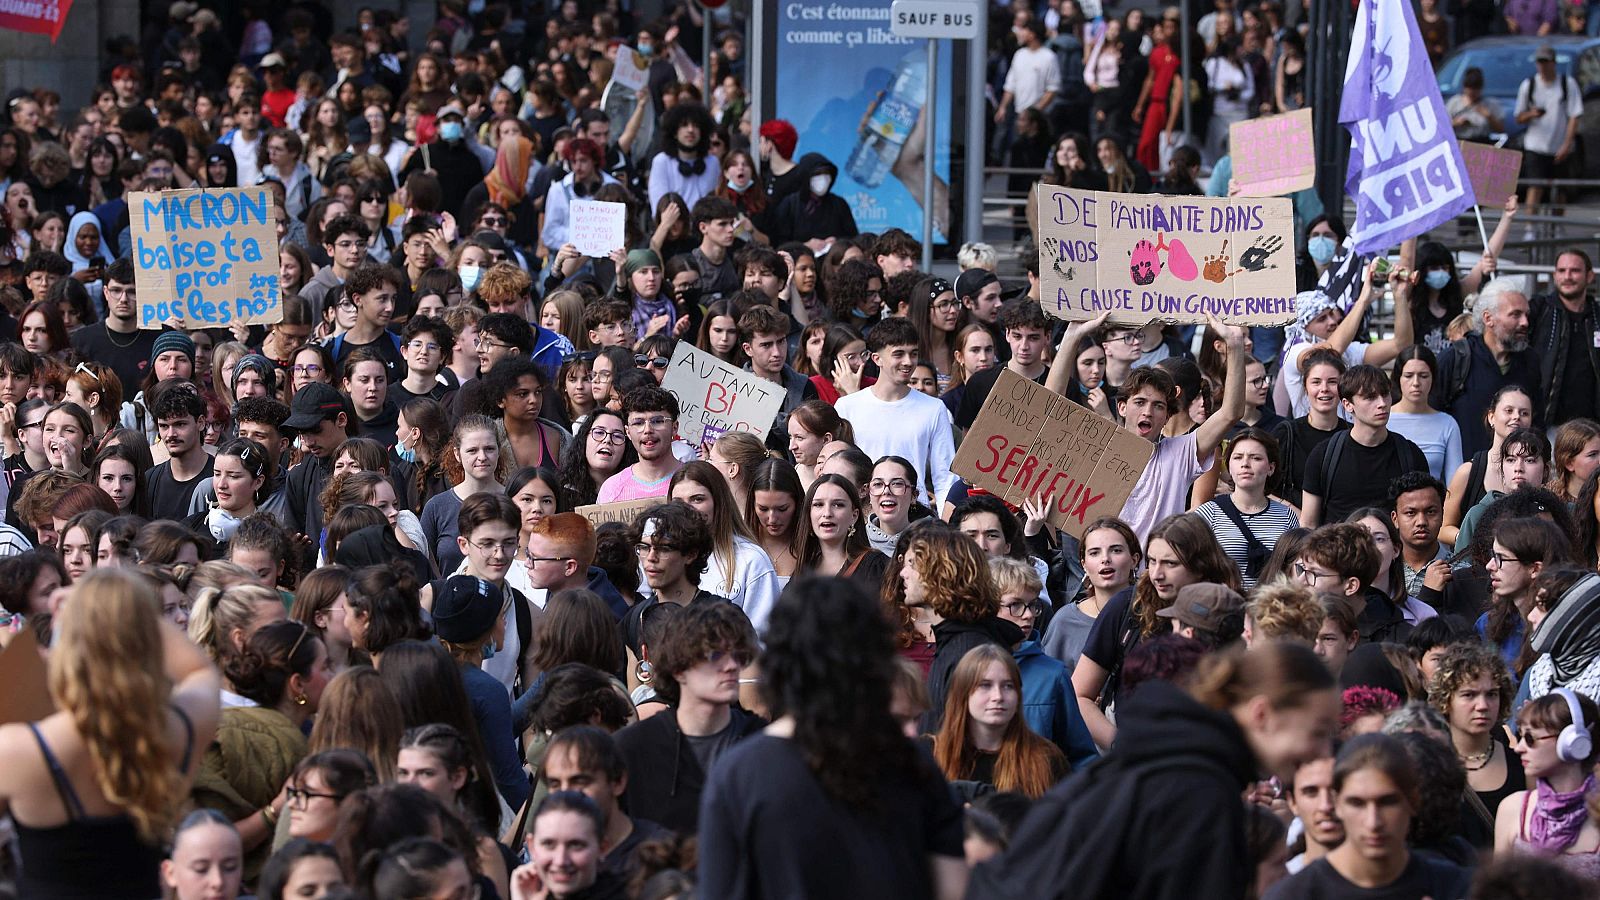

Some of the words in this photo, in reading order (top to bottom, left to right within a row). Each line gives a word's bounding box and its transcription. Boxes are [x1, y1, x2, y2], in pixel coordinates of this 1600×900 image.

[786, 3, 823, 20] C'est
[827, 2, 891, 20] étonnan
[898, 13, 937, 25] SAUF
[943, 14, 973, 26] BUS
[786, 31, 843, 44] comme
[846, 31, 863, 48] ça
[142, 191, 267, 233] MACRON
[1052, 192, 1098, 228] DE
[1209, 205, 1264, 234] DANS
[137, 234, 216, 270] baise
[220, 230, 263, 262] ta
[1060, 240, 1098, 262] NOS
[175, 262, 233, 299] prof
[142, 299, 184, 327] pas
[187, 289, 232, 324] les
[1057, 288, 1071, 311] A
[1081, 288, 1134, 311] CAUSE
[1142, 291, 1183, 313] D'UN
[678, 351, 770, 403] AUTANT
[1011, 379, 1037, 406] ON
[1076, 413, 1103, 440] PAS
[988, 394, 1040, 432] MONDE
[1056, 428, 1104, 463] JUSTE
[1105, 453, 1138, 482] ÊTRE
[1031, 436, 1056, 461] PRIS
[1055, 453, 1074, 472] AU
